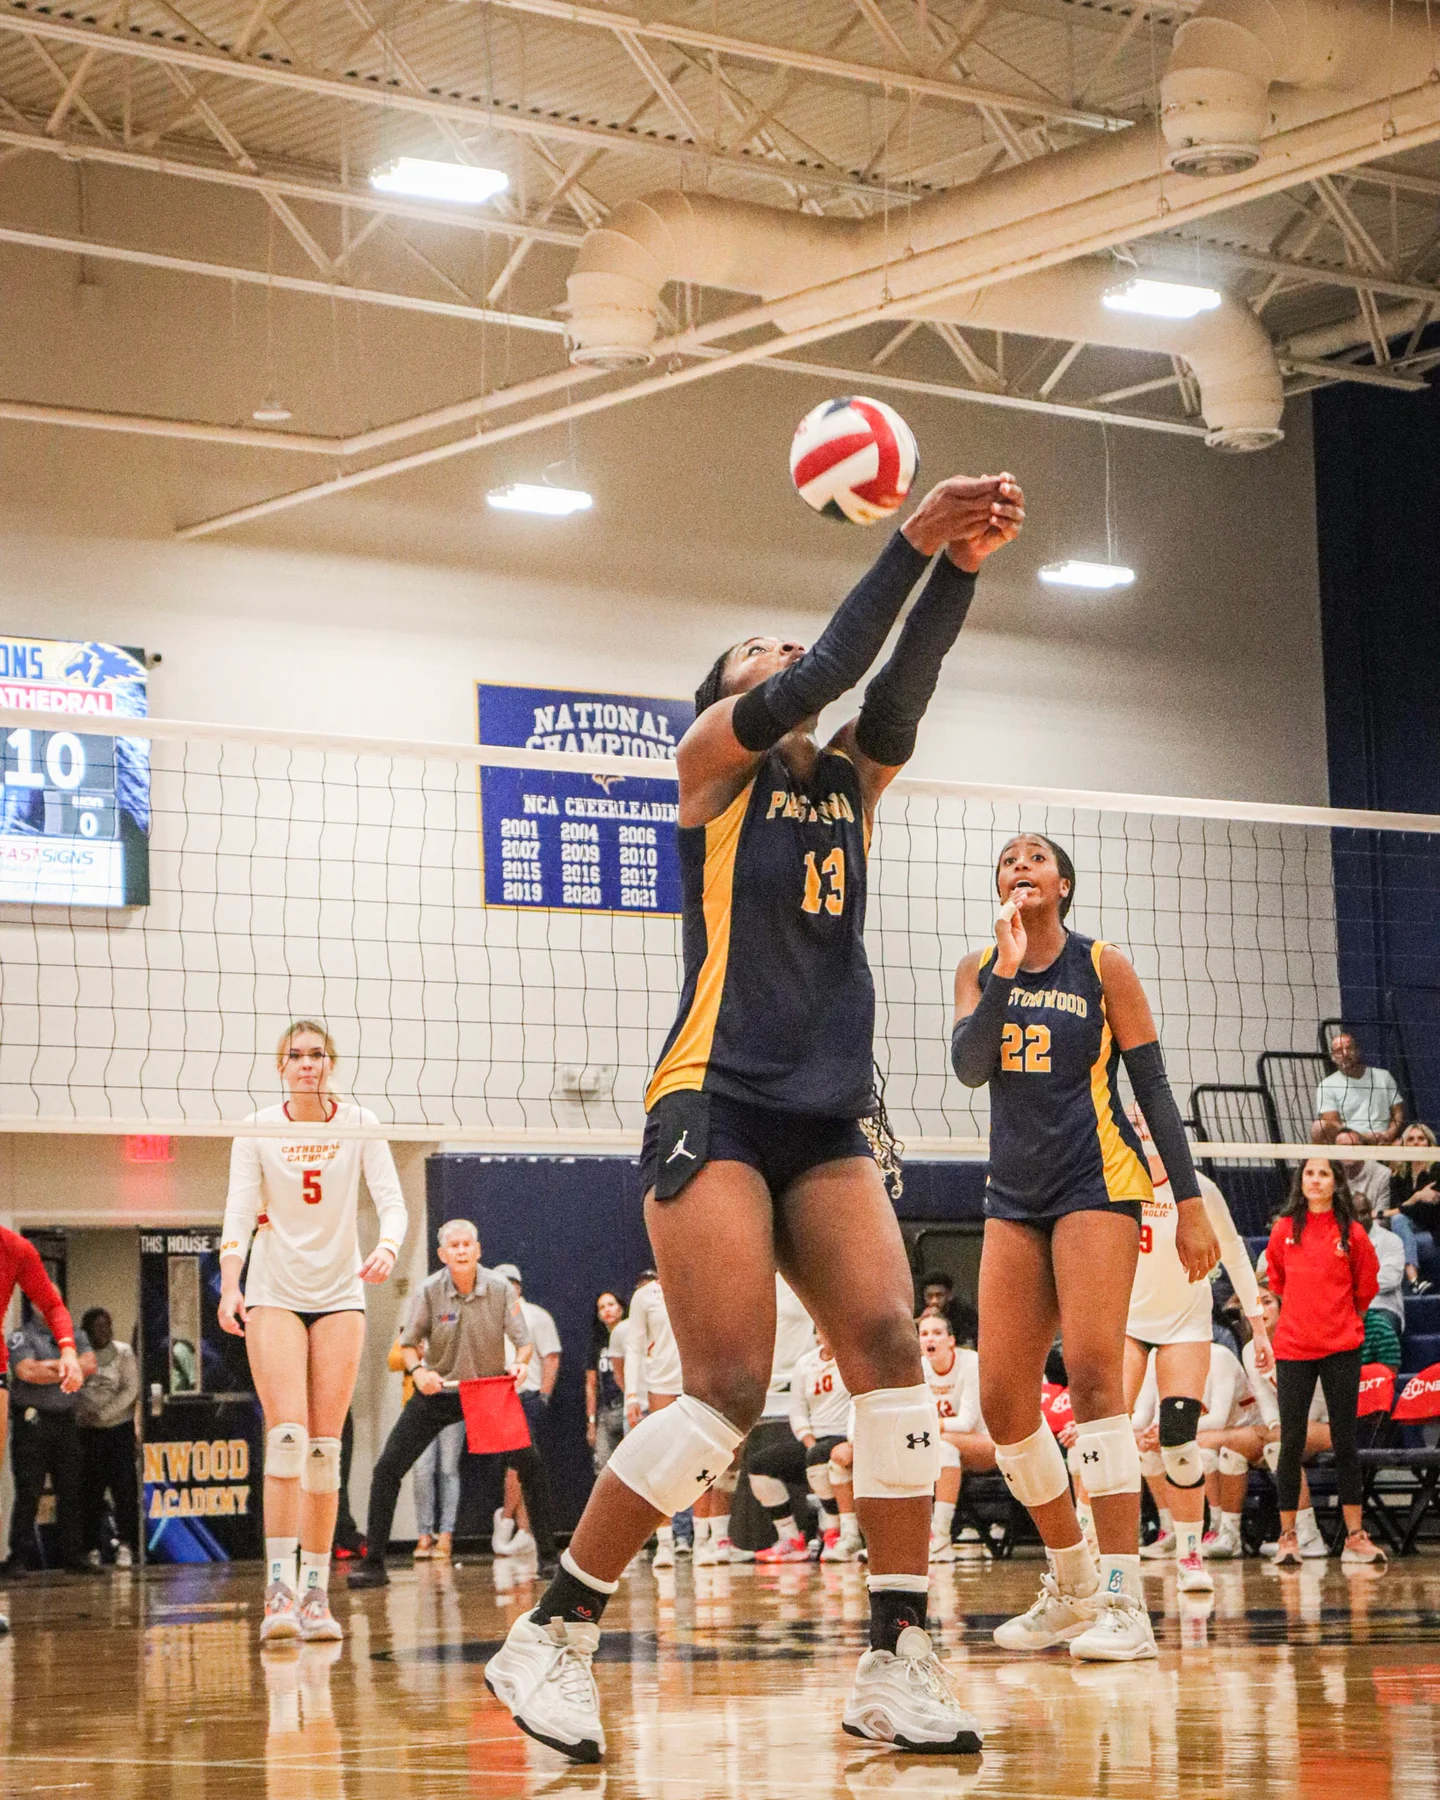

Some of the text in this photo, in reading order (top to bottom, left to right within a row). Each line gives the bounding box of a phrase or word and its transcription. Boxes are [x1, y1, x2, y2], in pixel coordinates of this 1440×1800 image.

[534, 702, 676, 745] NATIONAL
[4, 729, 86, 790] 10
[523, 794, 559, 815] NCA
[80, 812, 98, 837] 0
[501, 818, 656, 844] 2001 2004 2006
[501, 840, 657, 866] 2007 2009 2010
[502, 861, 541, 880] 2015
[620, 868, 657, 887] 2017
[801, 847, 845, 915] 13
[503, 882, 657, 908] 2019 2020 2021
[1001, 1023, 1051, 1072] 22
[281, 1141, 340, 1153] CATHEDRAL
[302, 1170, 322, 1204] 5
[140, 1235, 163, 1253] THIS
[167, 1235, 212, 1253] HOUSE
[1140, 1224, 1153, 1254] 9
[814, 1374, 833, 1395] 10
[143, 1439, 249, 1483] NWOOD
[149, 1485, 250, 1519] ACADEMY
